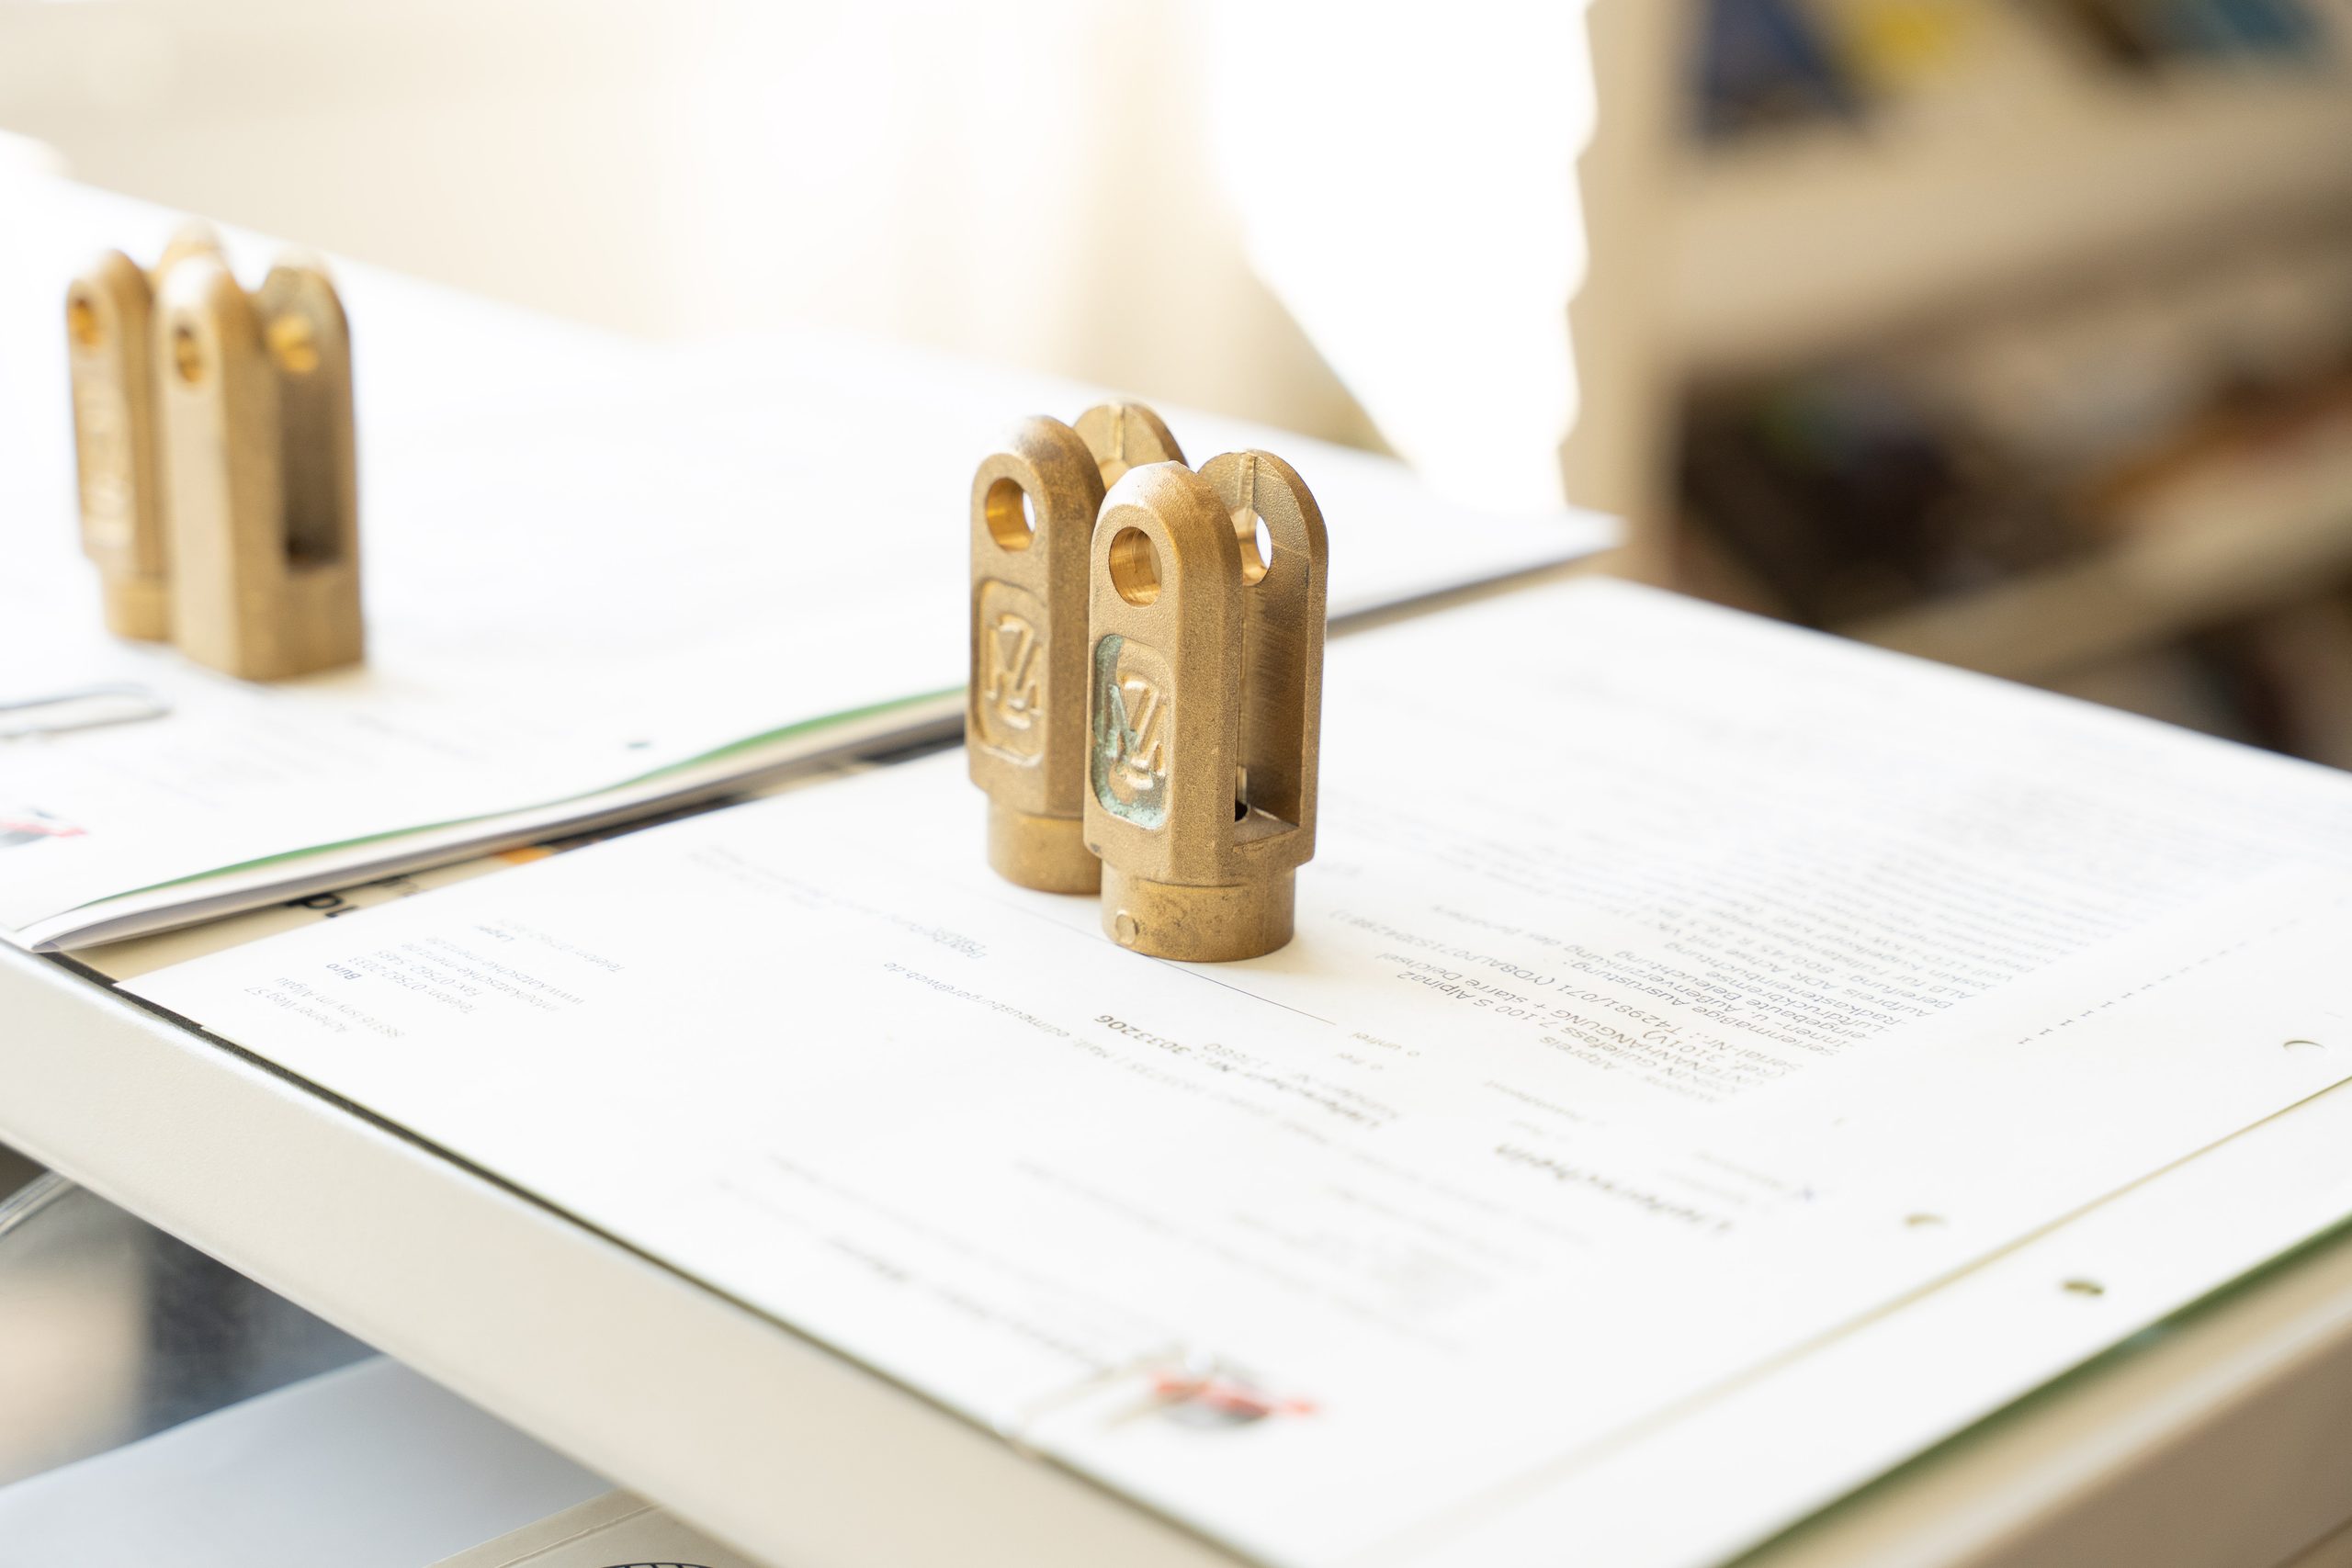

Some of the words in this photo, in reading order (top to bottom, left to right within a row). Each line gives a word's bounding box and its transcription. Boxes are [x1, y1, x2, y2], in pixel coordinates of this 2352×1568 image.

[325, 963, 362, 980] Büro
[1376, 953, 1463, 984] Deichsel
[1563, 959, 1690, 1005] Ausrüstung:
[1614, 951, 1742, 1000] Beleuchtung
[1790, 972, 1837, 989] ADR
[1396, 971, 1475, 998] Alpina2
[1464, 978, 1528, 1002] starre
[1849, 975, 1953, 1009] Bereifung:
[1494, 1005, 1557, 1028] 7.100
[1556, 984, 1681, 1034] T42981/071
[1842, 988, 1932, 1017] Aufpreis
[1094, 1014, 1191, 1054] 3033206
